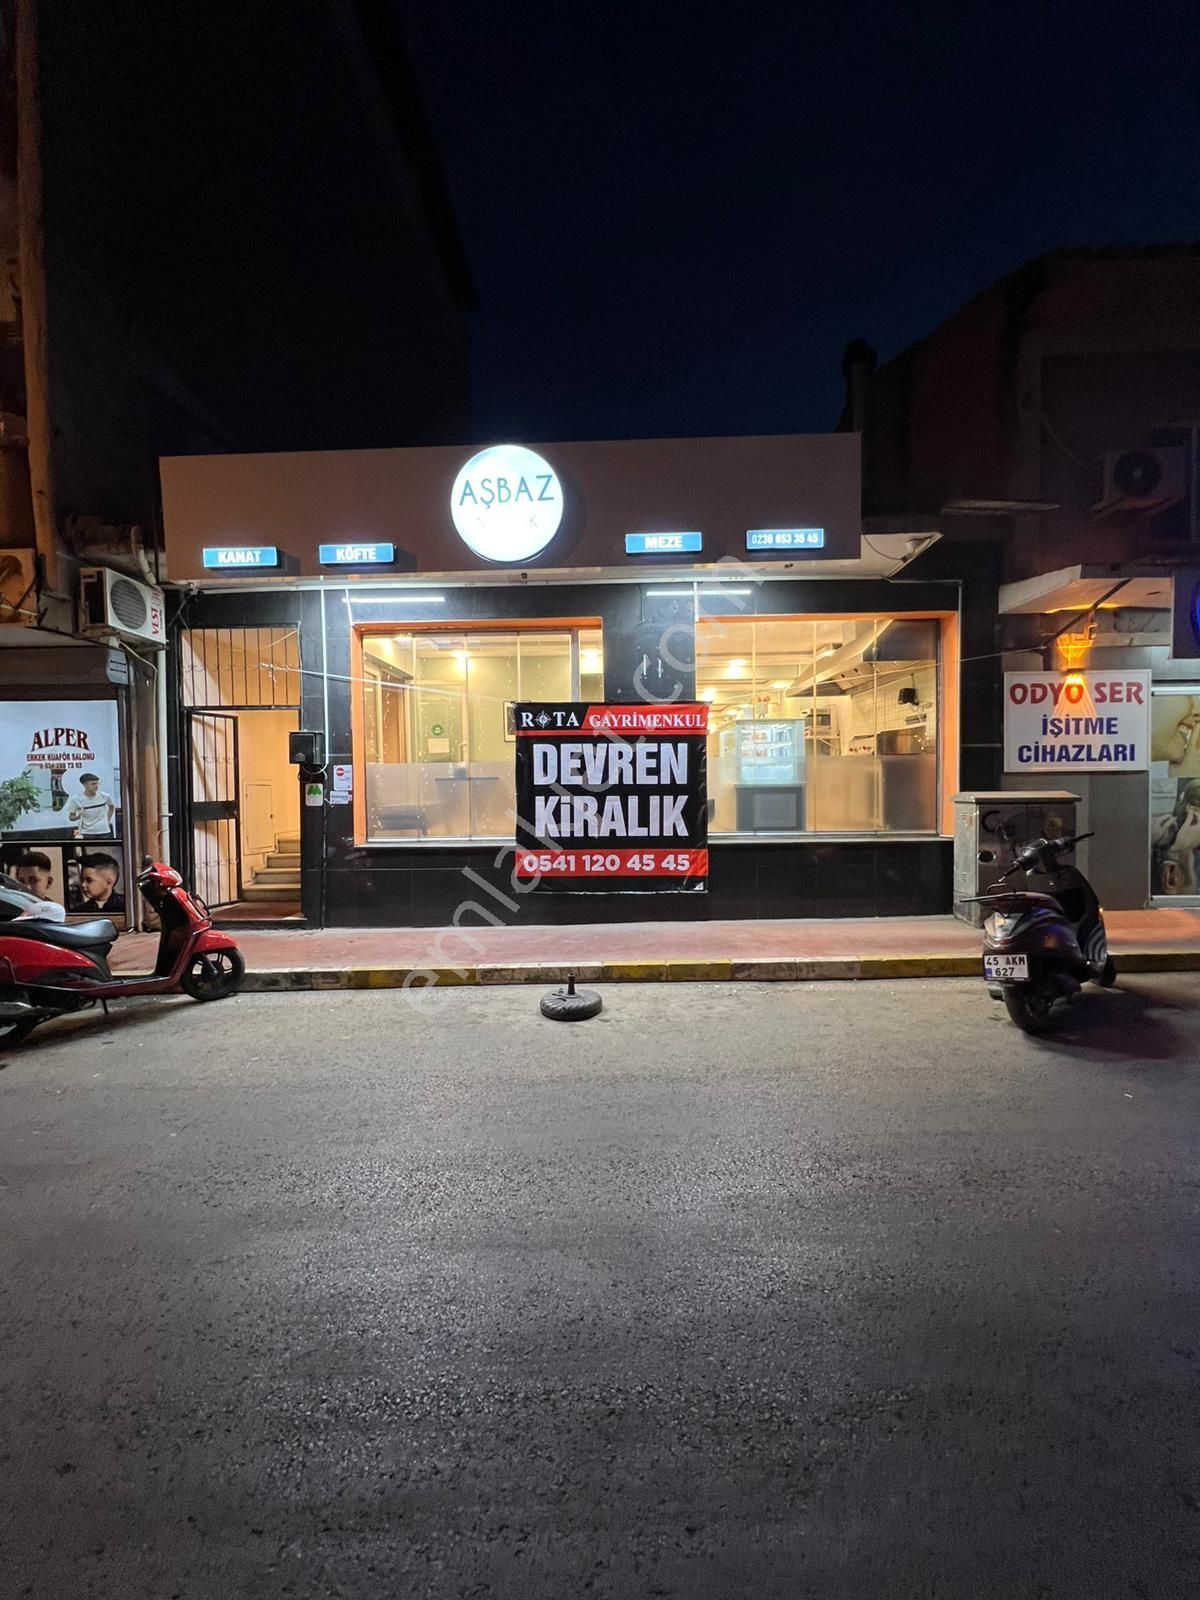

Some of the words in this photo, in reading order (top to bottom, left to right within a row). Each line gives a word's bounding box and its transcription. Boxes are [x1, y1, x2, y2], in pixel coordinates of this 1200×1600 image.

[459, 474, 554, 509] AŞBAZ
[645, 535, 683, 549] MEZE
[807, 532, 818, 543] 45
[217, 550, 261, 564] KANAT
[335, 545, 377, 561] KÖFTE
[1009, 682, 1084, 706] ODYO
[1094, 682, 1144, 705] SER
[588, 712, 706, 728] GAYRİMENKUL
[1041, 714, 1119, 738] İŞİTME
[31, 727, 90, 752] ALPER
[26, 753, 46, 761] ERKEK
[72, 752, 95, 761] SALONU
[1018, 741, 1136, 763] CİHAZLARI
[532, 743, 688, 785] DEVREN
[523, 854, 576, 872] 0541
[582, 854, 620, 872] 120
[626, 854, 655, 872] 45
[661, 854, 690, 872] 45
[986, 957, 999, 966] 45
[1005, 956, 1026, 966] AKM
[995, 967, 1015, 977] 627
